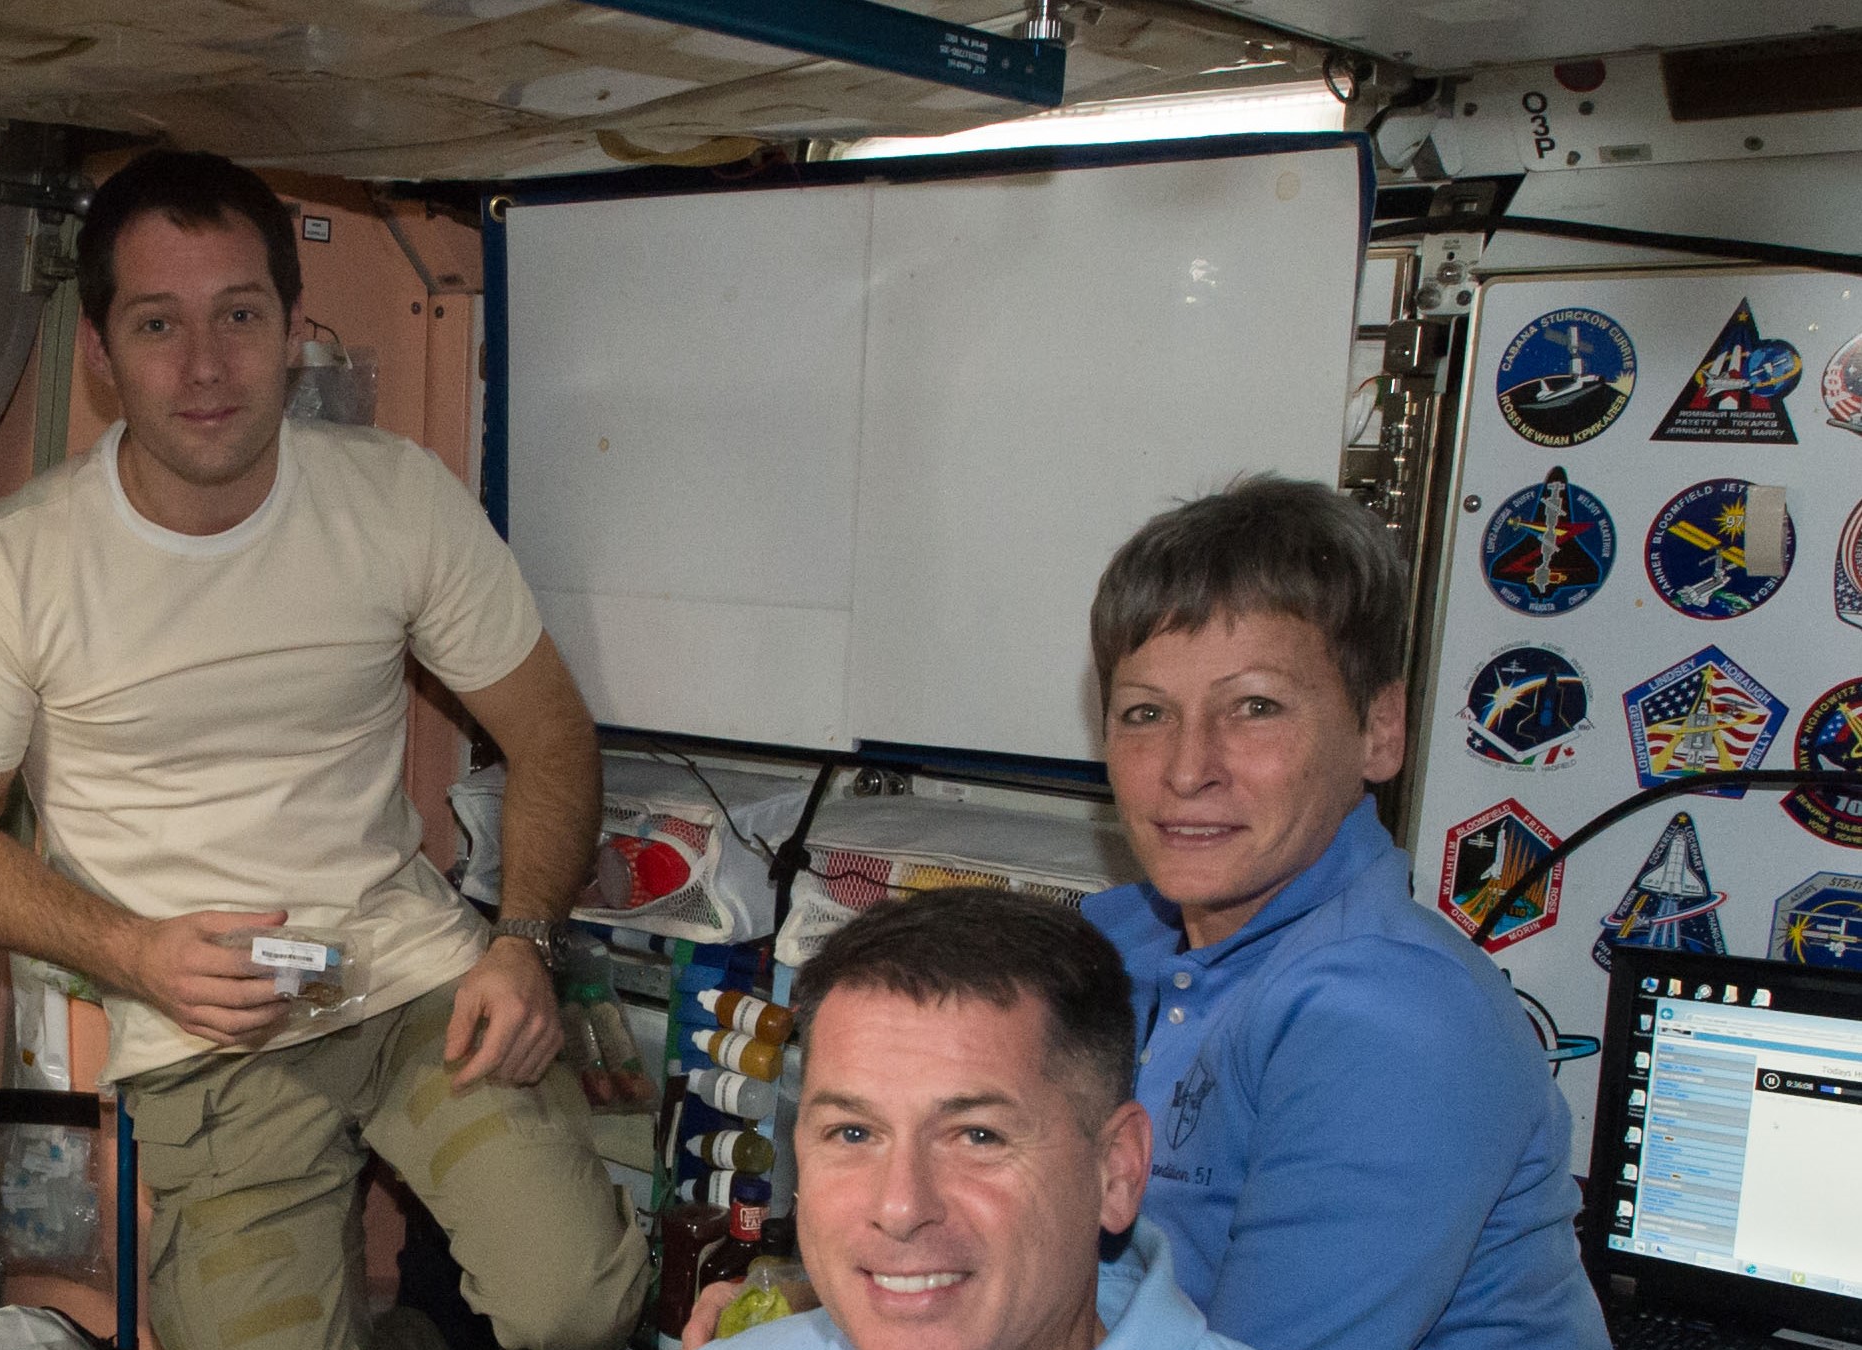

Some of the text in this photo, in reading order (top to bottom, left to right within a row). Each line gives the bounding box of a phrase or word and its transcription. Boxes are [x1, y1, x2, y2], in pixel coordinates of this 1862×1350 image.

[1502, 311, 1635, 372] CABANA STURCKOW CURRIE
[1500, 396, 1570, 446] ROSS NEWMAN
[1675, 418, 1718, 426] PAYETTE
[1730, 411, 1776, 419] HUSBAND
[1752, 429, 1786, 437] BARRY
[1513, 491, 1536, 508] DUFFY
[1652, 483, 1746, 545] BLOOMFIELD JET
[1726, 515, 1745, 528] 97
[1650, 552, 1676, 597] TANNER
[1648, 658, 1696, 691] LINDSEY
[1720, 660, 1772, 705] HOBAUGH
[1628, 704, 1650, 775] GERNHARDT
[1456, 804, 1511, 836] BLOOMFIELD
[1523, 814, 1553, 842] FRICK
[1649, 824, 1680, 865] COCKRELL
[1684, 825, 1703, 871] LOCKHART
[1442, 841, 1458, 895] WALHEIM
[1549, 887, 1559, 914] ROSS
[1509, 921, 1541, 941] MORIN
[1195, 1167, 1213, 1187] 51
